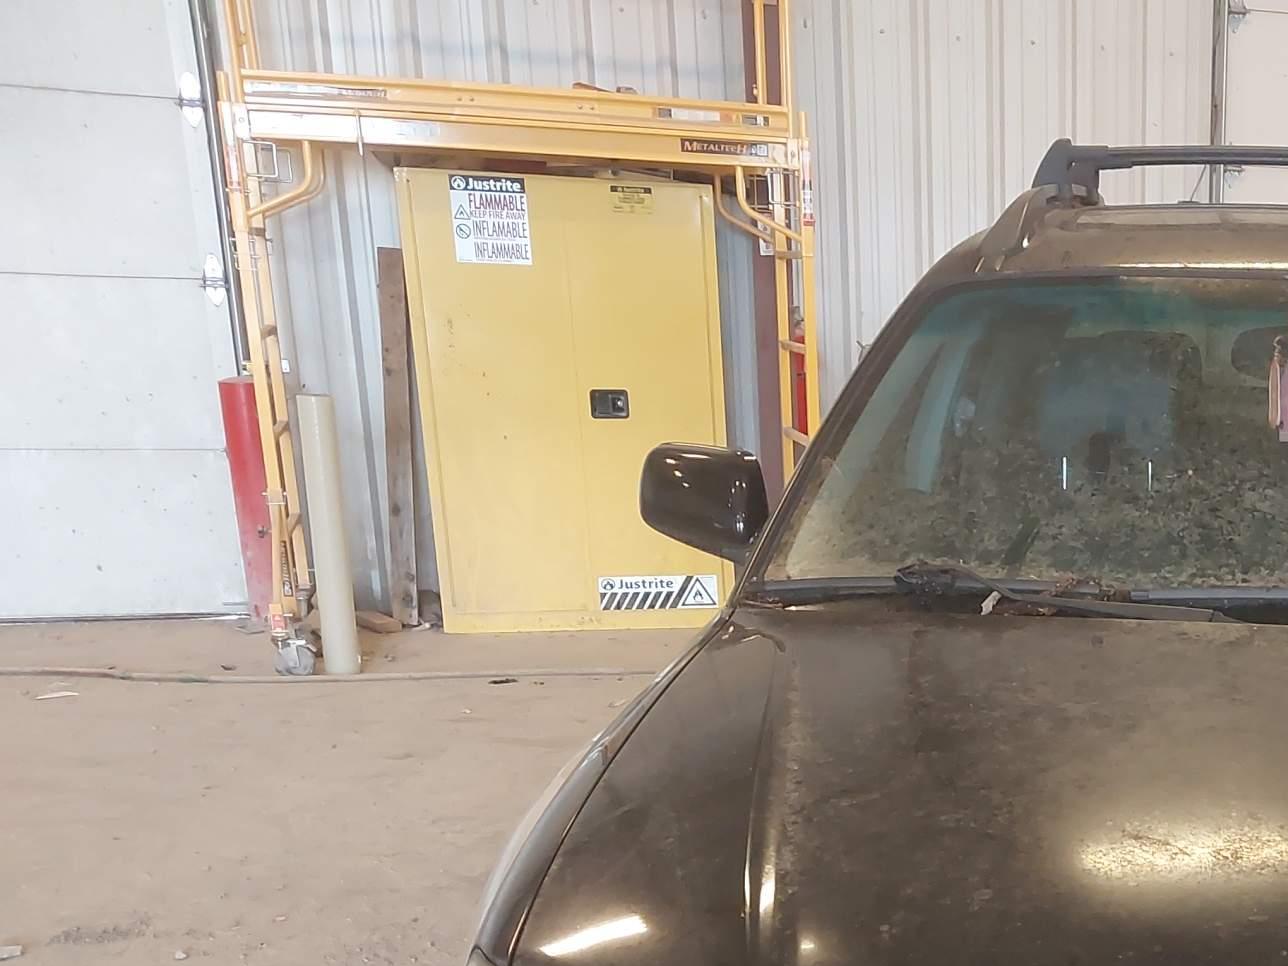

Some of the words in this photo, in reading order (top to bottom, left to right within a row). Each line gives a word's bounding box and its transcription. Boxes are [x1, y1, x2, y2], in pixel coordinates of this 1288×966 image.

[467, 177, 522, 192] Justrite
[468, 192, 526, 212] FLAMMABLE
[470, 209, 487, 219] KEEP
[488, 210, 504, 220] FIRE
[505, 210, 526, 221] AWAY
[472, 219, 528, 239] INFLAMABLE
[474, 241, 530, 260] INFLAMMABLE
[618, 578, 674, 590] Justrite
